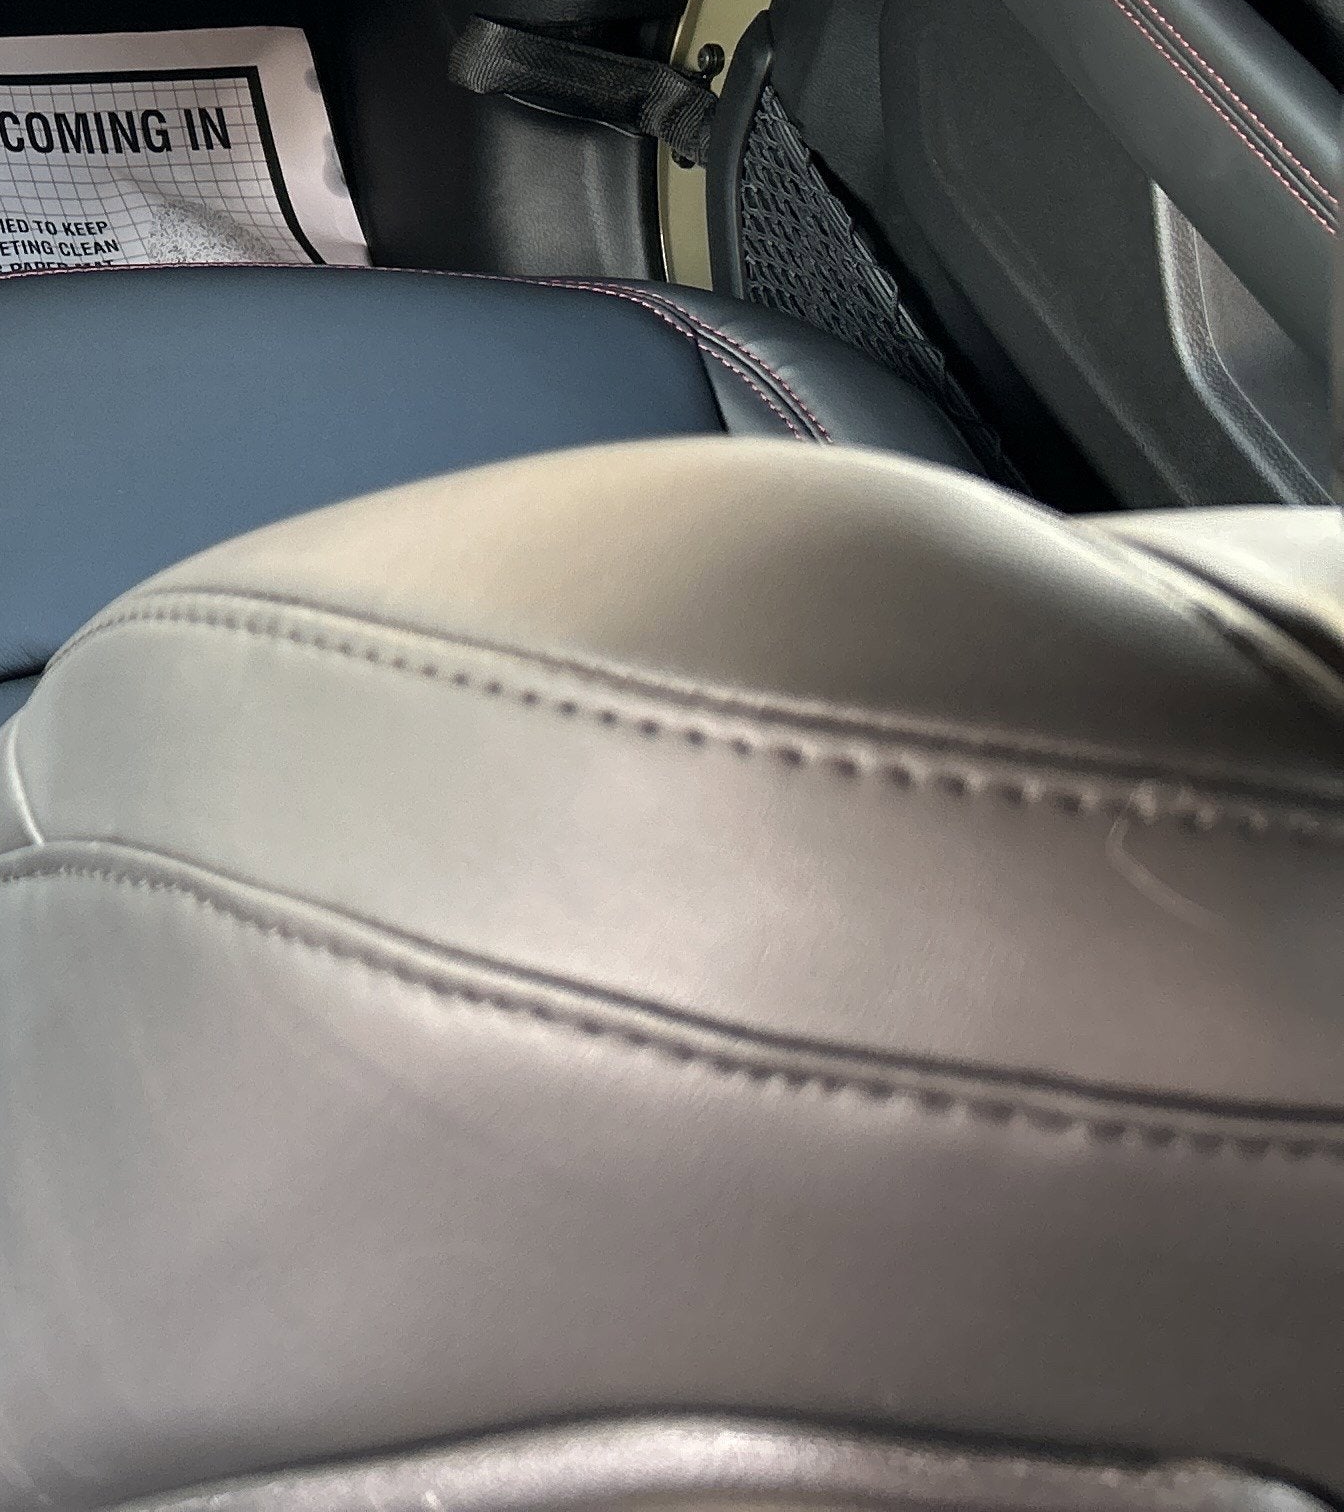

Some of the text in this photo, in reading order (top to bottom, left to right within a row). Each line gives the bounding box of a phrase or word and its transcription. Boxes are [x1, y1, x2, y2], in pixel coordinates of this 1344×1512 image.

[183, 107, 232, 151] IN
[32, 220, 59, 236] TO
[61, 221, 109, 237] KEEP
[58, 238, 121, 258] CLEAN
